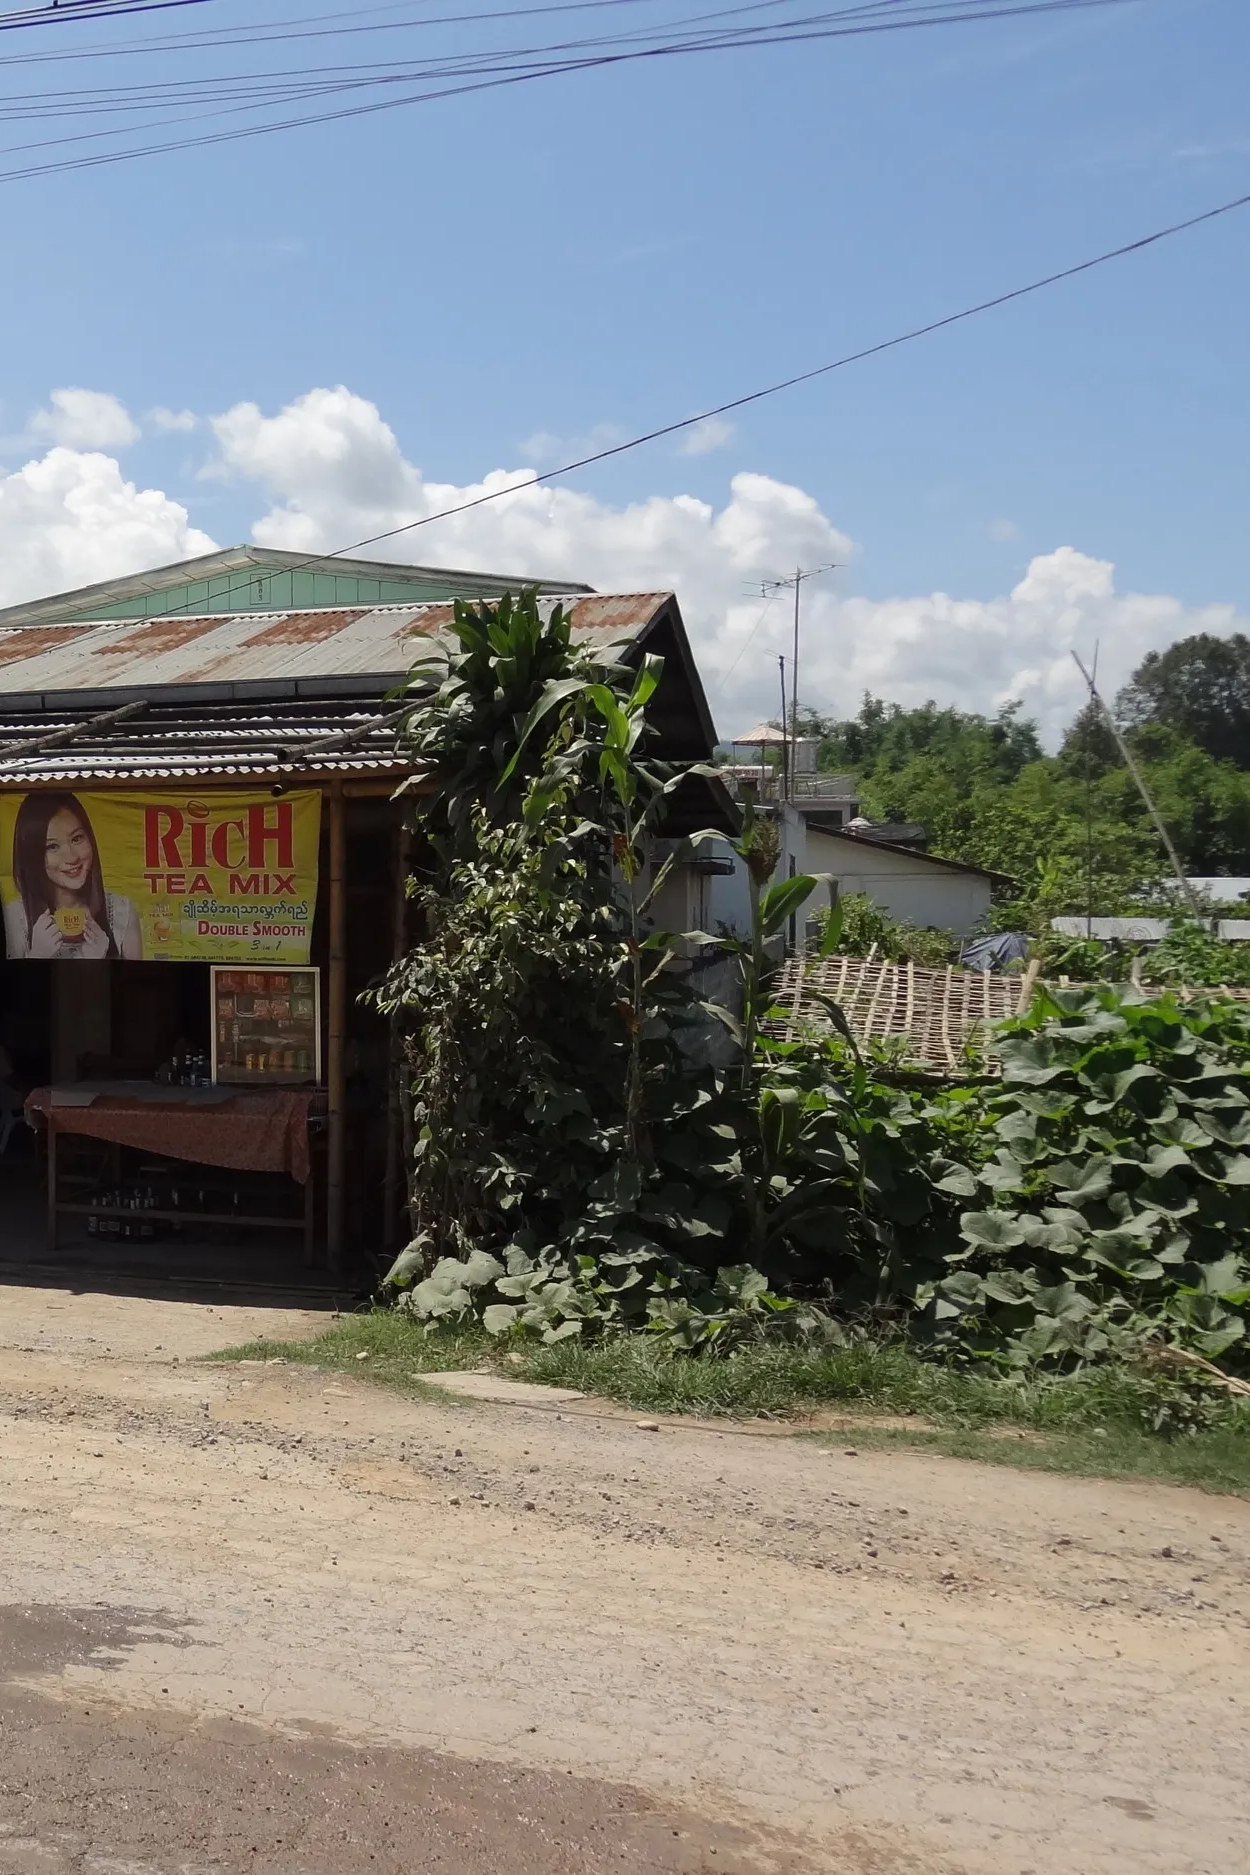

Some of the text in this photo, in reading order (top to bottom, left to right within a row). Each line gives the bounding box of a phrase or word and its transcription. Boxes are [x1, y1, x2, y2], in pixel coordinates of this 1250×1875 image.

[143, 873, 297, 895] TEA MIX
[198, 920, 305, 936] DOUBLE SMOOTH
[250, 940, 260, 950] 3
[275, 940, 282, 951] 1
